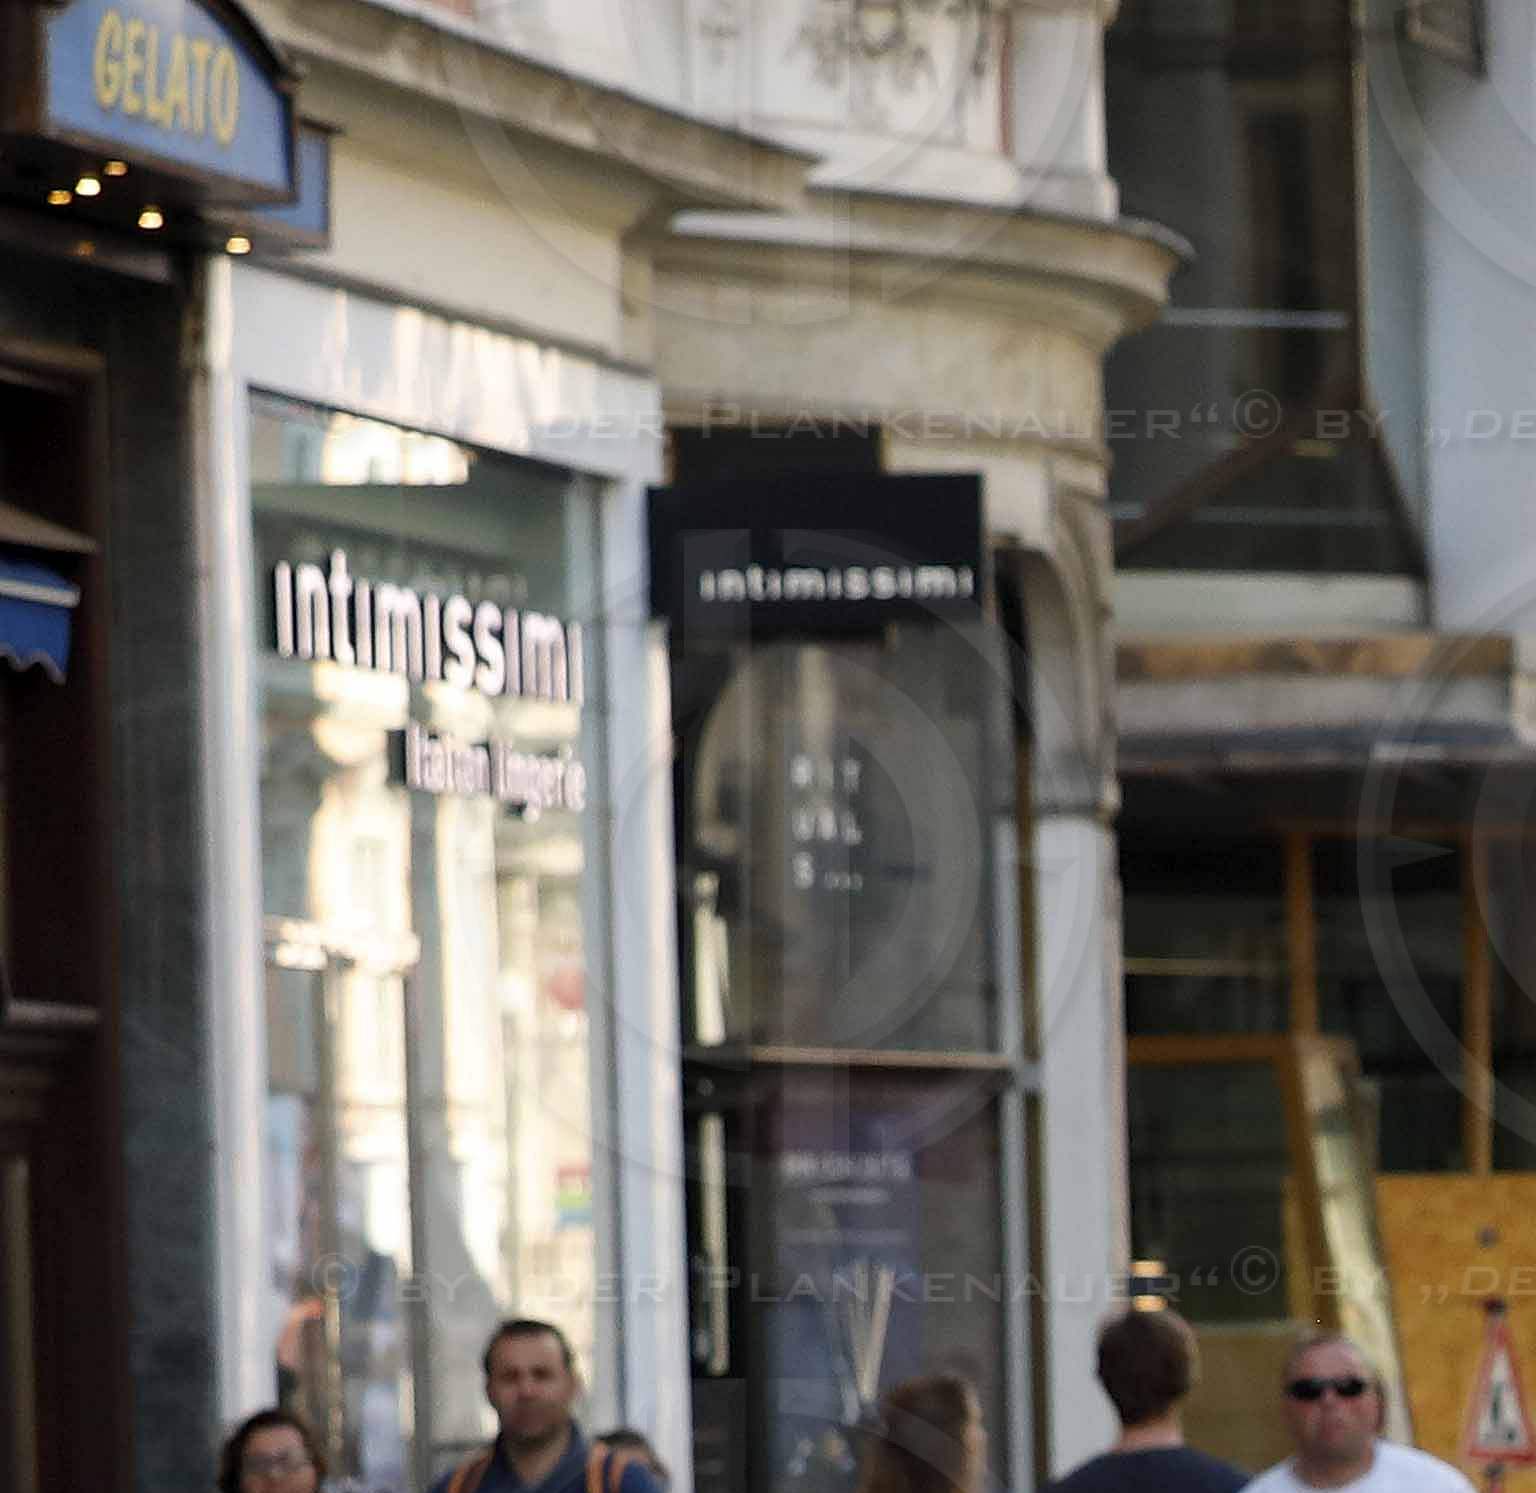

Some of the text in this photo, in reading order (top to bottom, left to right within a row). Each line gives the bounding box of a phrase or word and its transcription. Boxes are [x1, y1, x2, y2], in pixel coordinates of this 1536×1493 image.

[95, 9, 239, 145] GELATO
[275, 548, 584, 704] intimissimi
[699, 563, 975, 602] intimissimi
